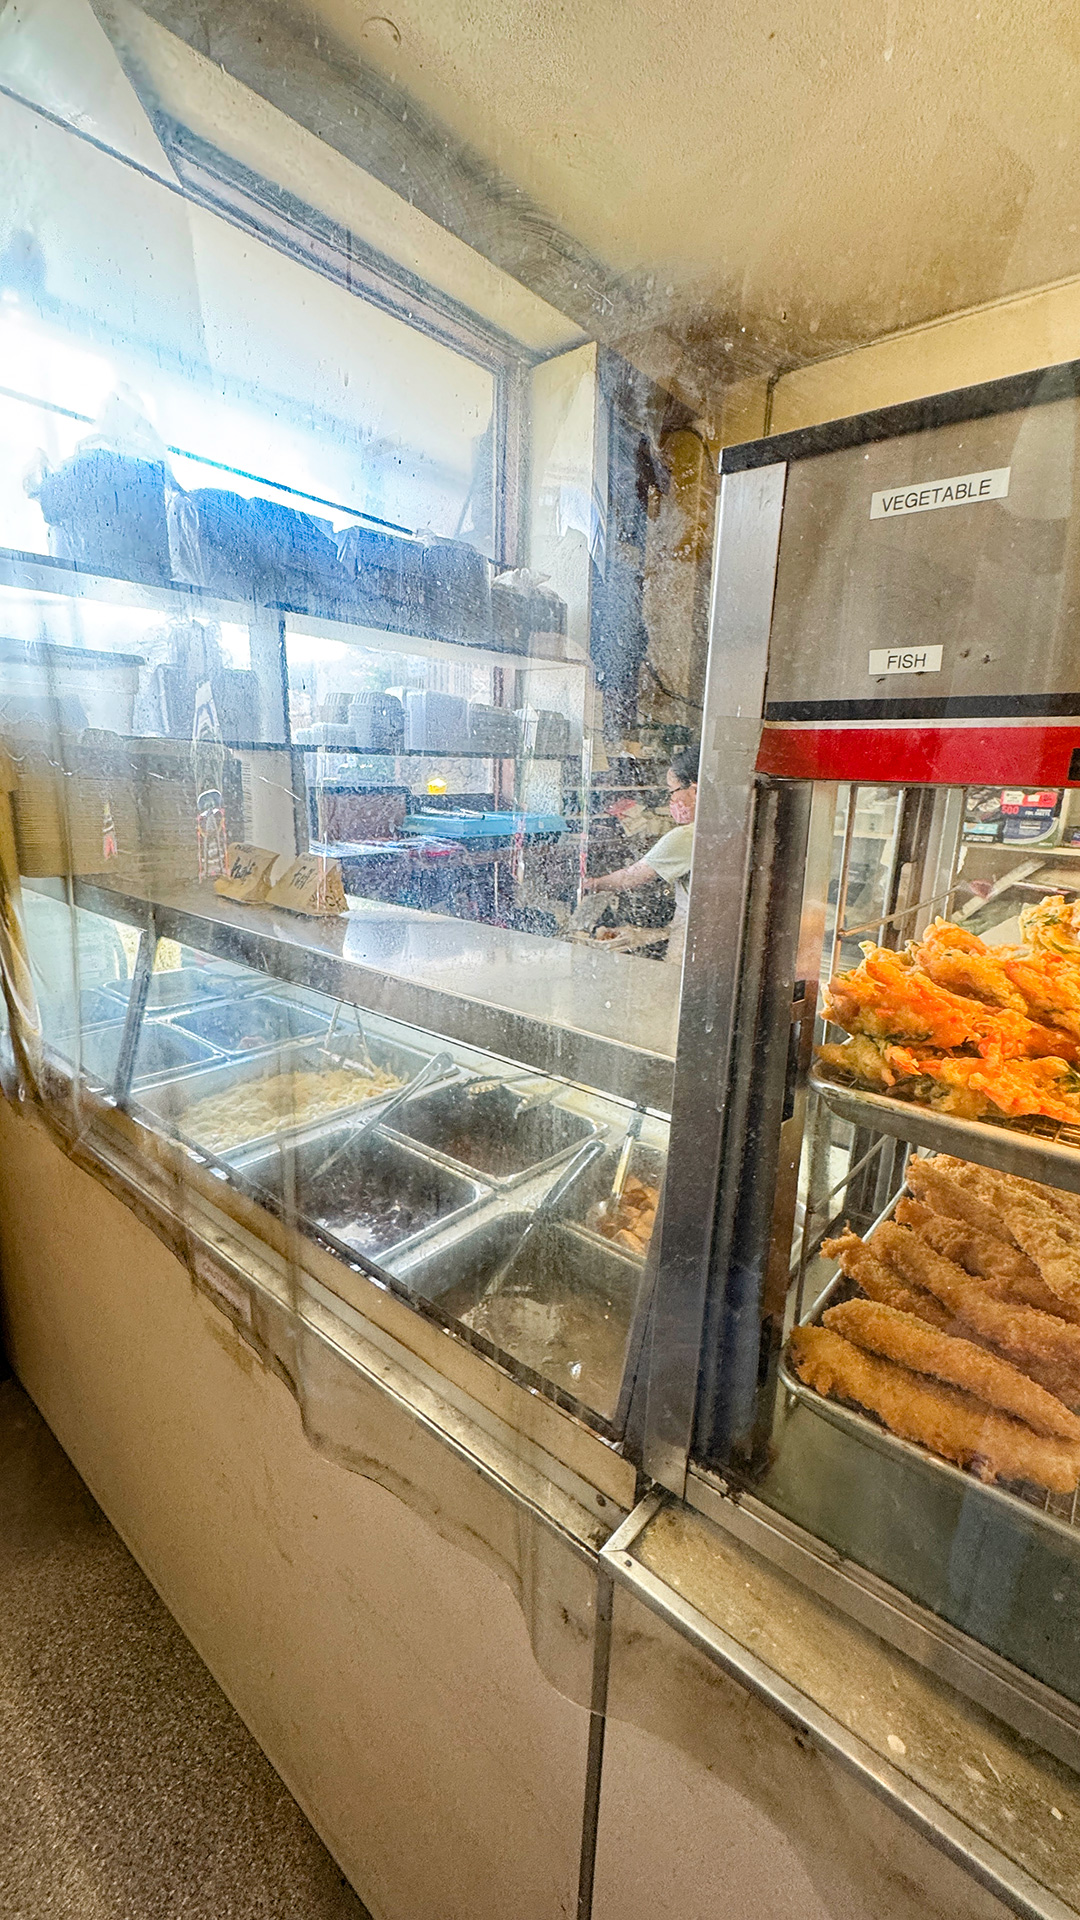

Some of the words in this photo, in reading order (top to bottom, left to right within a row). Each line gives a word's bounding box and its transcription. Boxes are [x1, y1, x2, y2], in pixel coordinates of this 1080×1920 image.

[882, 478, 993, 513] VEGETABLE
[887, 653, 927, 670] FISH
[1001, 805, 1020, 815] 500
